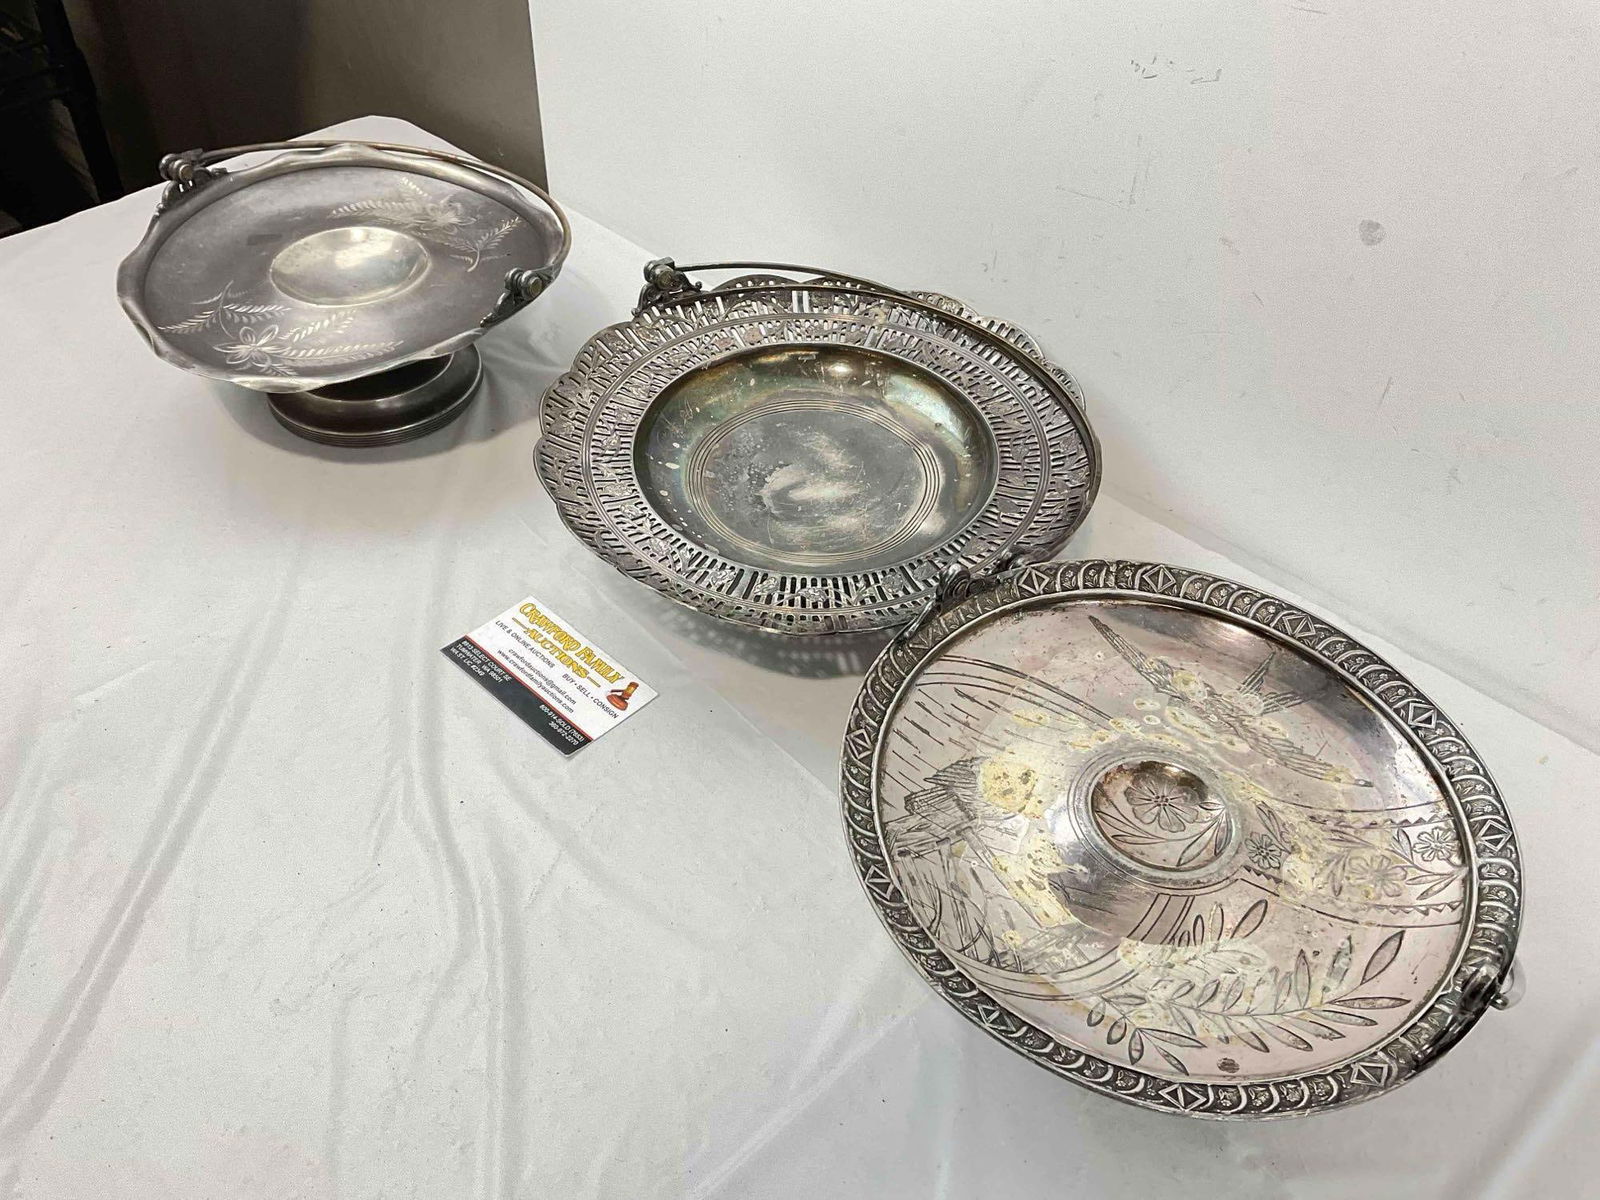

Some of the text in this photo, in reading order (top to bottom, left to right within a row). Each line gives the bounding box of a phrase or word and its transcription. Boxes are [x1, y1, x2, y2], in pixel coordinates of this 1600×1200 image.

[471, 649, 491, 663] SELECT
[487, 661, 506, 675] COURT
[495, 620, 509, 631] LIVE
[511, 632, 532, 649] ONLINE
[529, 647, 556, 668] AUCTIONS
[520, 603, 625, 684] CRAWFORD FAMILY
[523, 628, 589, 678] AUCTIONS
[497, 649, 574, 713] www.crawfordfamilyauctions.com
[508, 649, 577, 705] crawfordauctions@gmail.com
[562, 673, 619, 718] BUY SELL CONSIGN
